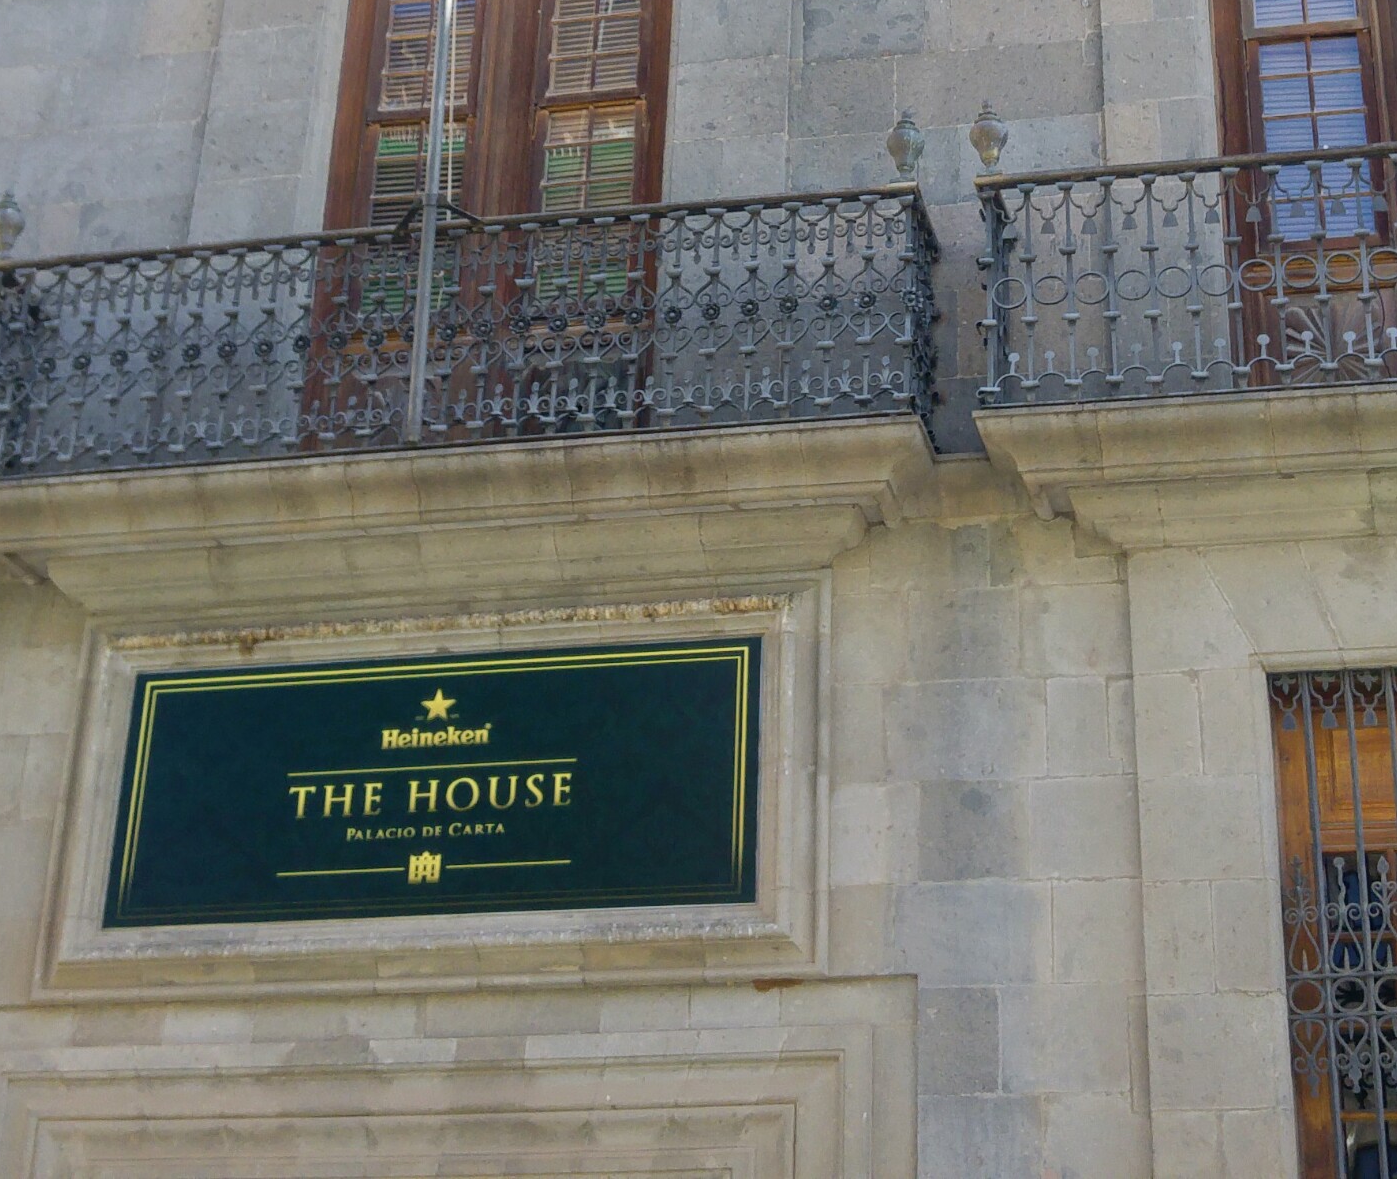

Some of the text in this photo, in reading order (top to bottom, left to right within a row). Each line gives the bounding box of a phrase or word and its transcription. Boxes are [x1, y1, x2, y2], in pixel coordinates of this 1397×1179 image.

[381, 725, 489, 749] Heineken
[288, 772, 573, 819] THE HOUSE
